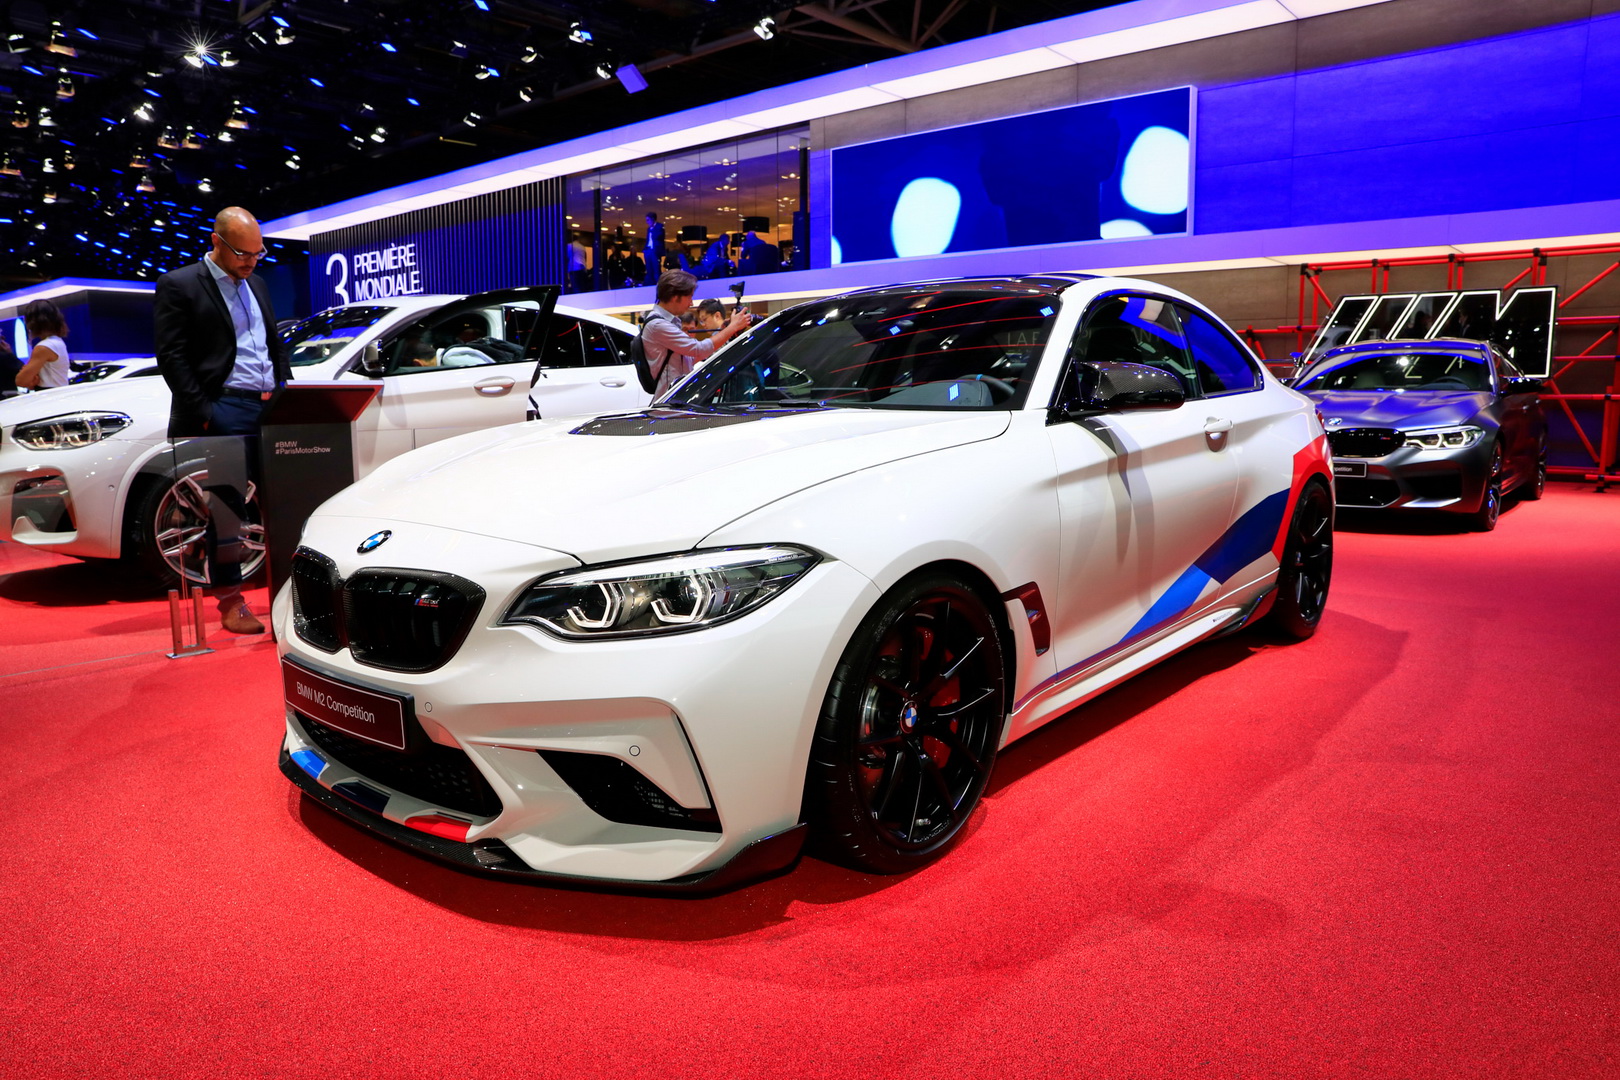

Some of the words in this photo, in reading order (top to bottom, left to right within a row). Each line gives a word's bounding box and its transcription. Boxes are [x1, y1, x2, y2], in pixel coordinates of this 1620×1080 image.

[326, 253, 350, 304] 3
[354, 243, 416, 276] PREMIÈRE
[297, 681, 313, 701] BMW
[314, 690, 326, 706] M2
[326, 696, 375, 724] Competition
